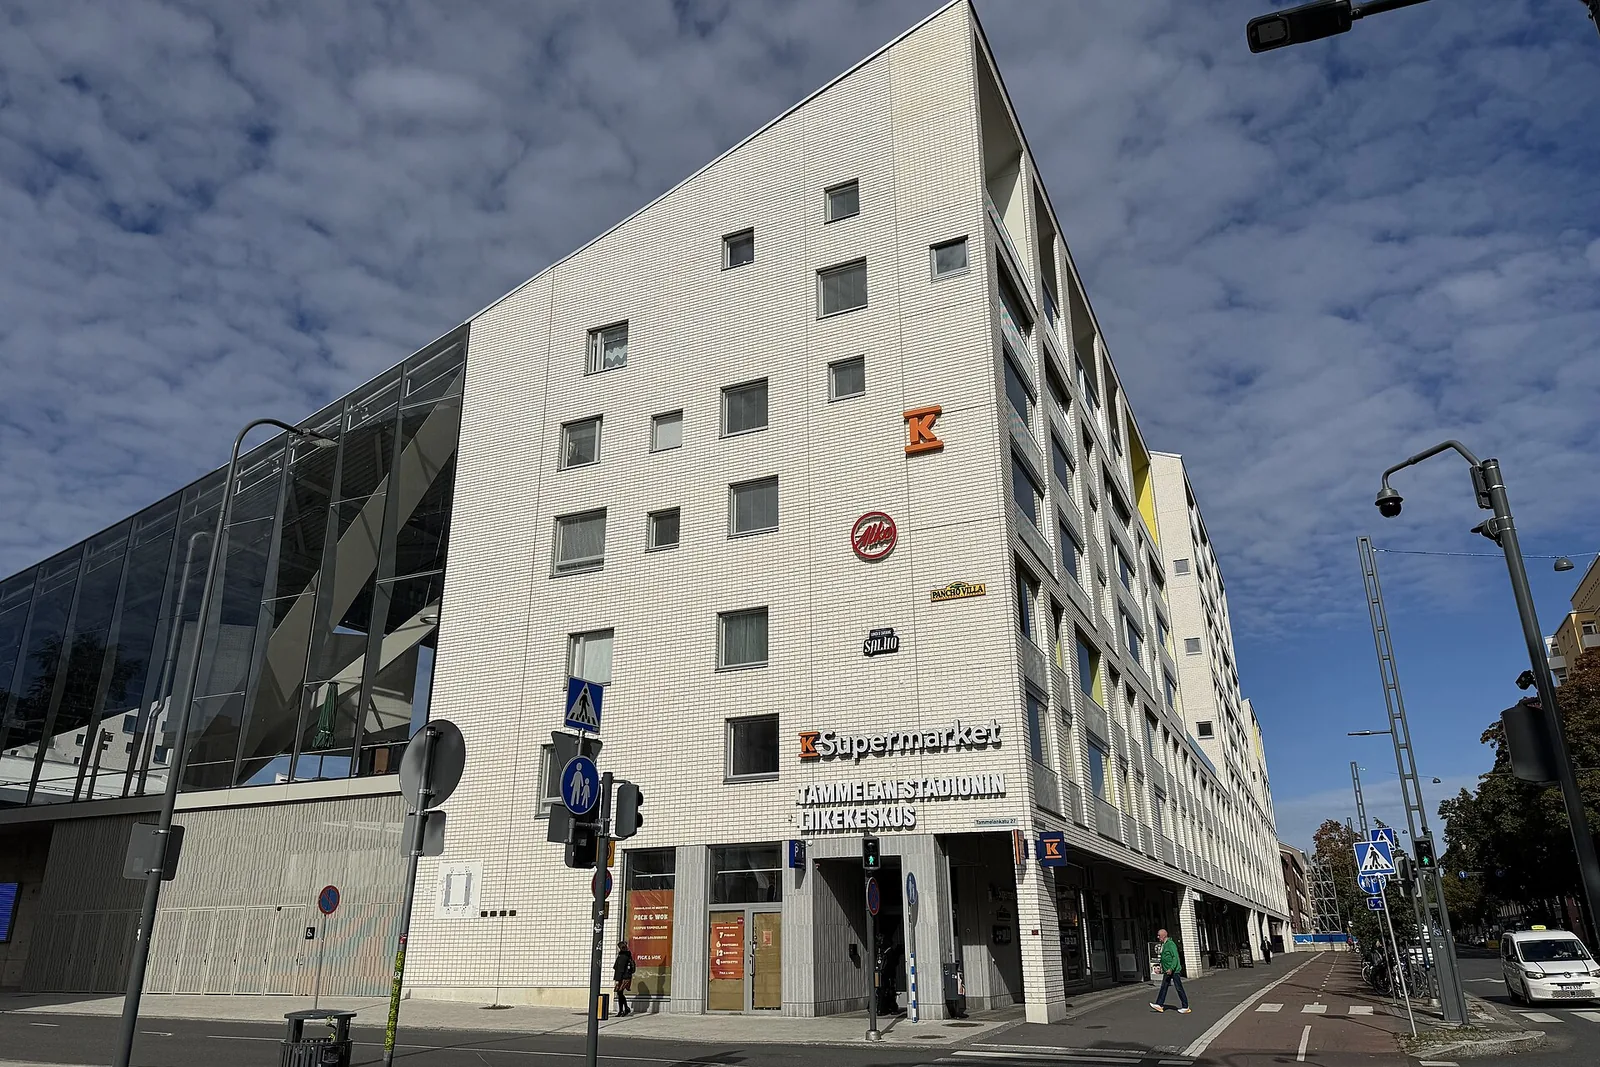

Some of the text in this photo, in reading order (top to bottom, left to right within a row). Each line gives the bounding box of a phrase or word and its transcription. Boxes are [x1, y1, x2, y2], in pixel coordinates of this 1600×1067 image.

[905, 408, 941, 450] K
[856, 521, 892, 547] Alko
[932, 585, 983, 598] PANCHO VILLA
[799, 719, 1000, 759] K Supermarket
[798, 774, 1005, 804] TAMMELAN STADIONIN
[798, 806, 916, 830] LIIKEKESKUS
[1044, 840, 1061, 857] K
